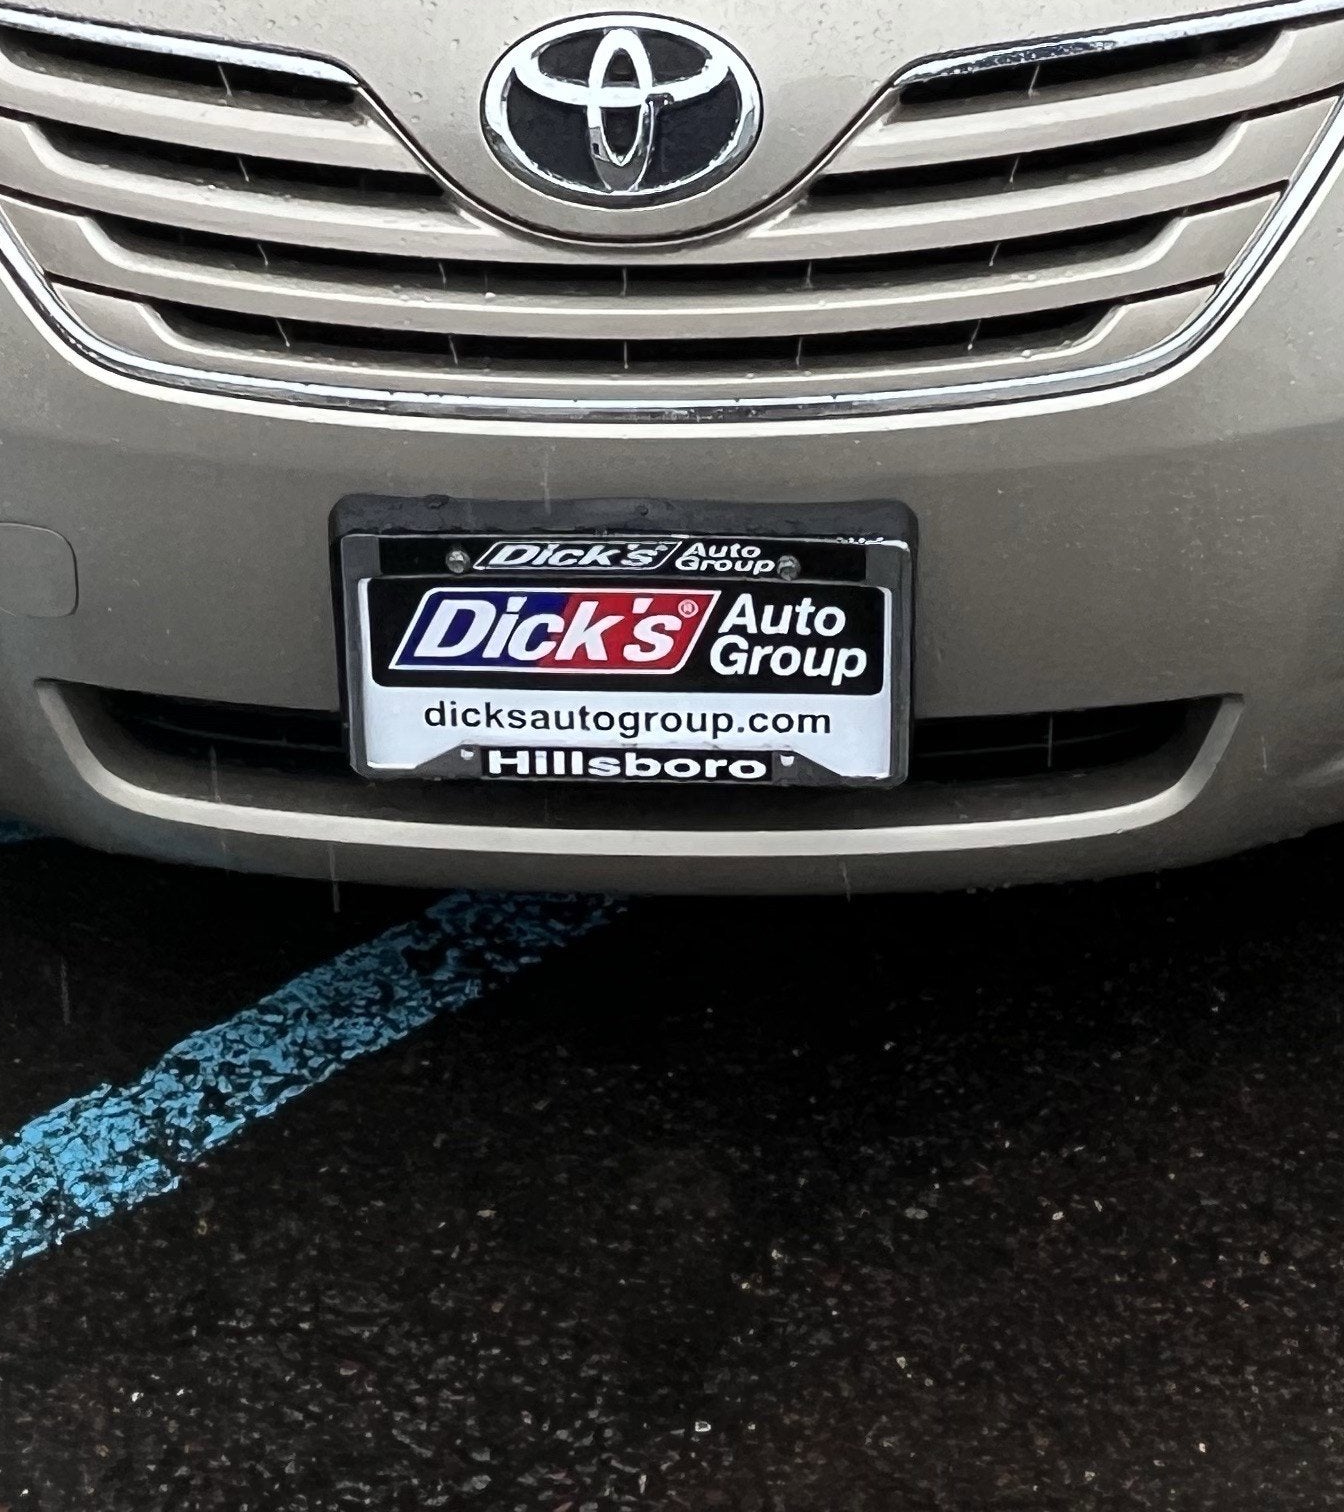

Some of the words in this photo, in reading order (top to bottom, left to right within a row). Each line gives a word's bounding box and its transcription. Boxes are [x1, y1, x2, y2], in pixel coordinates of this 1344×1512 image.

[488, 542, 668, 567] Dick's
[681, 542, 761, 559] Auto
[674, 556, 776, 576] Group
[717, 593, 846, 637] Auto
[709, 636, 868, 686] Group
[423, 700, 832, 739] dicksautogroup.com
[487, 749, 768, 779] Hillsboro
